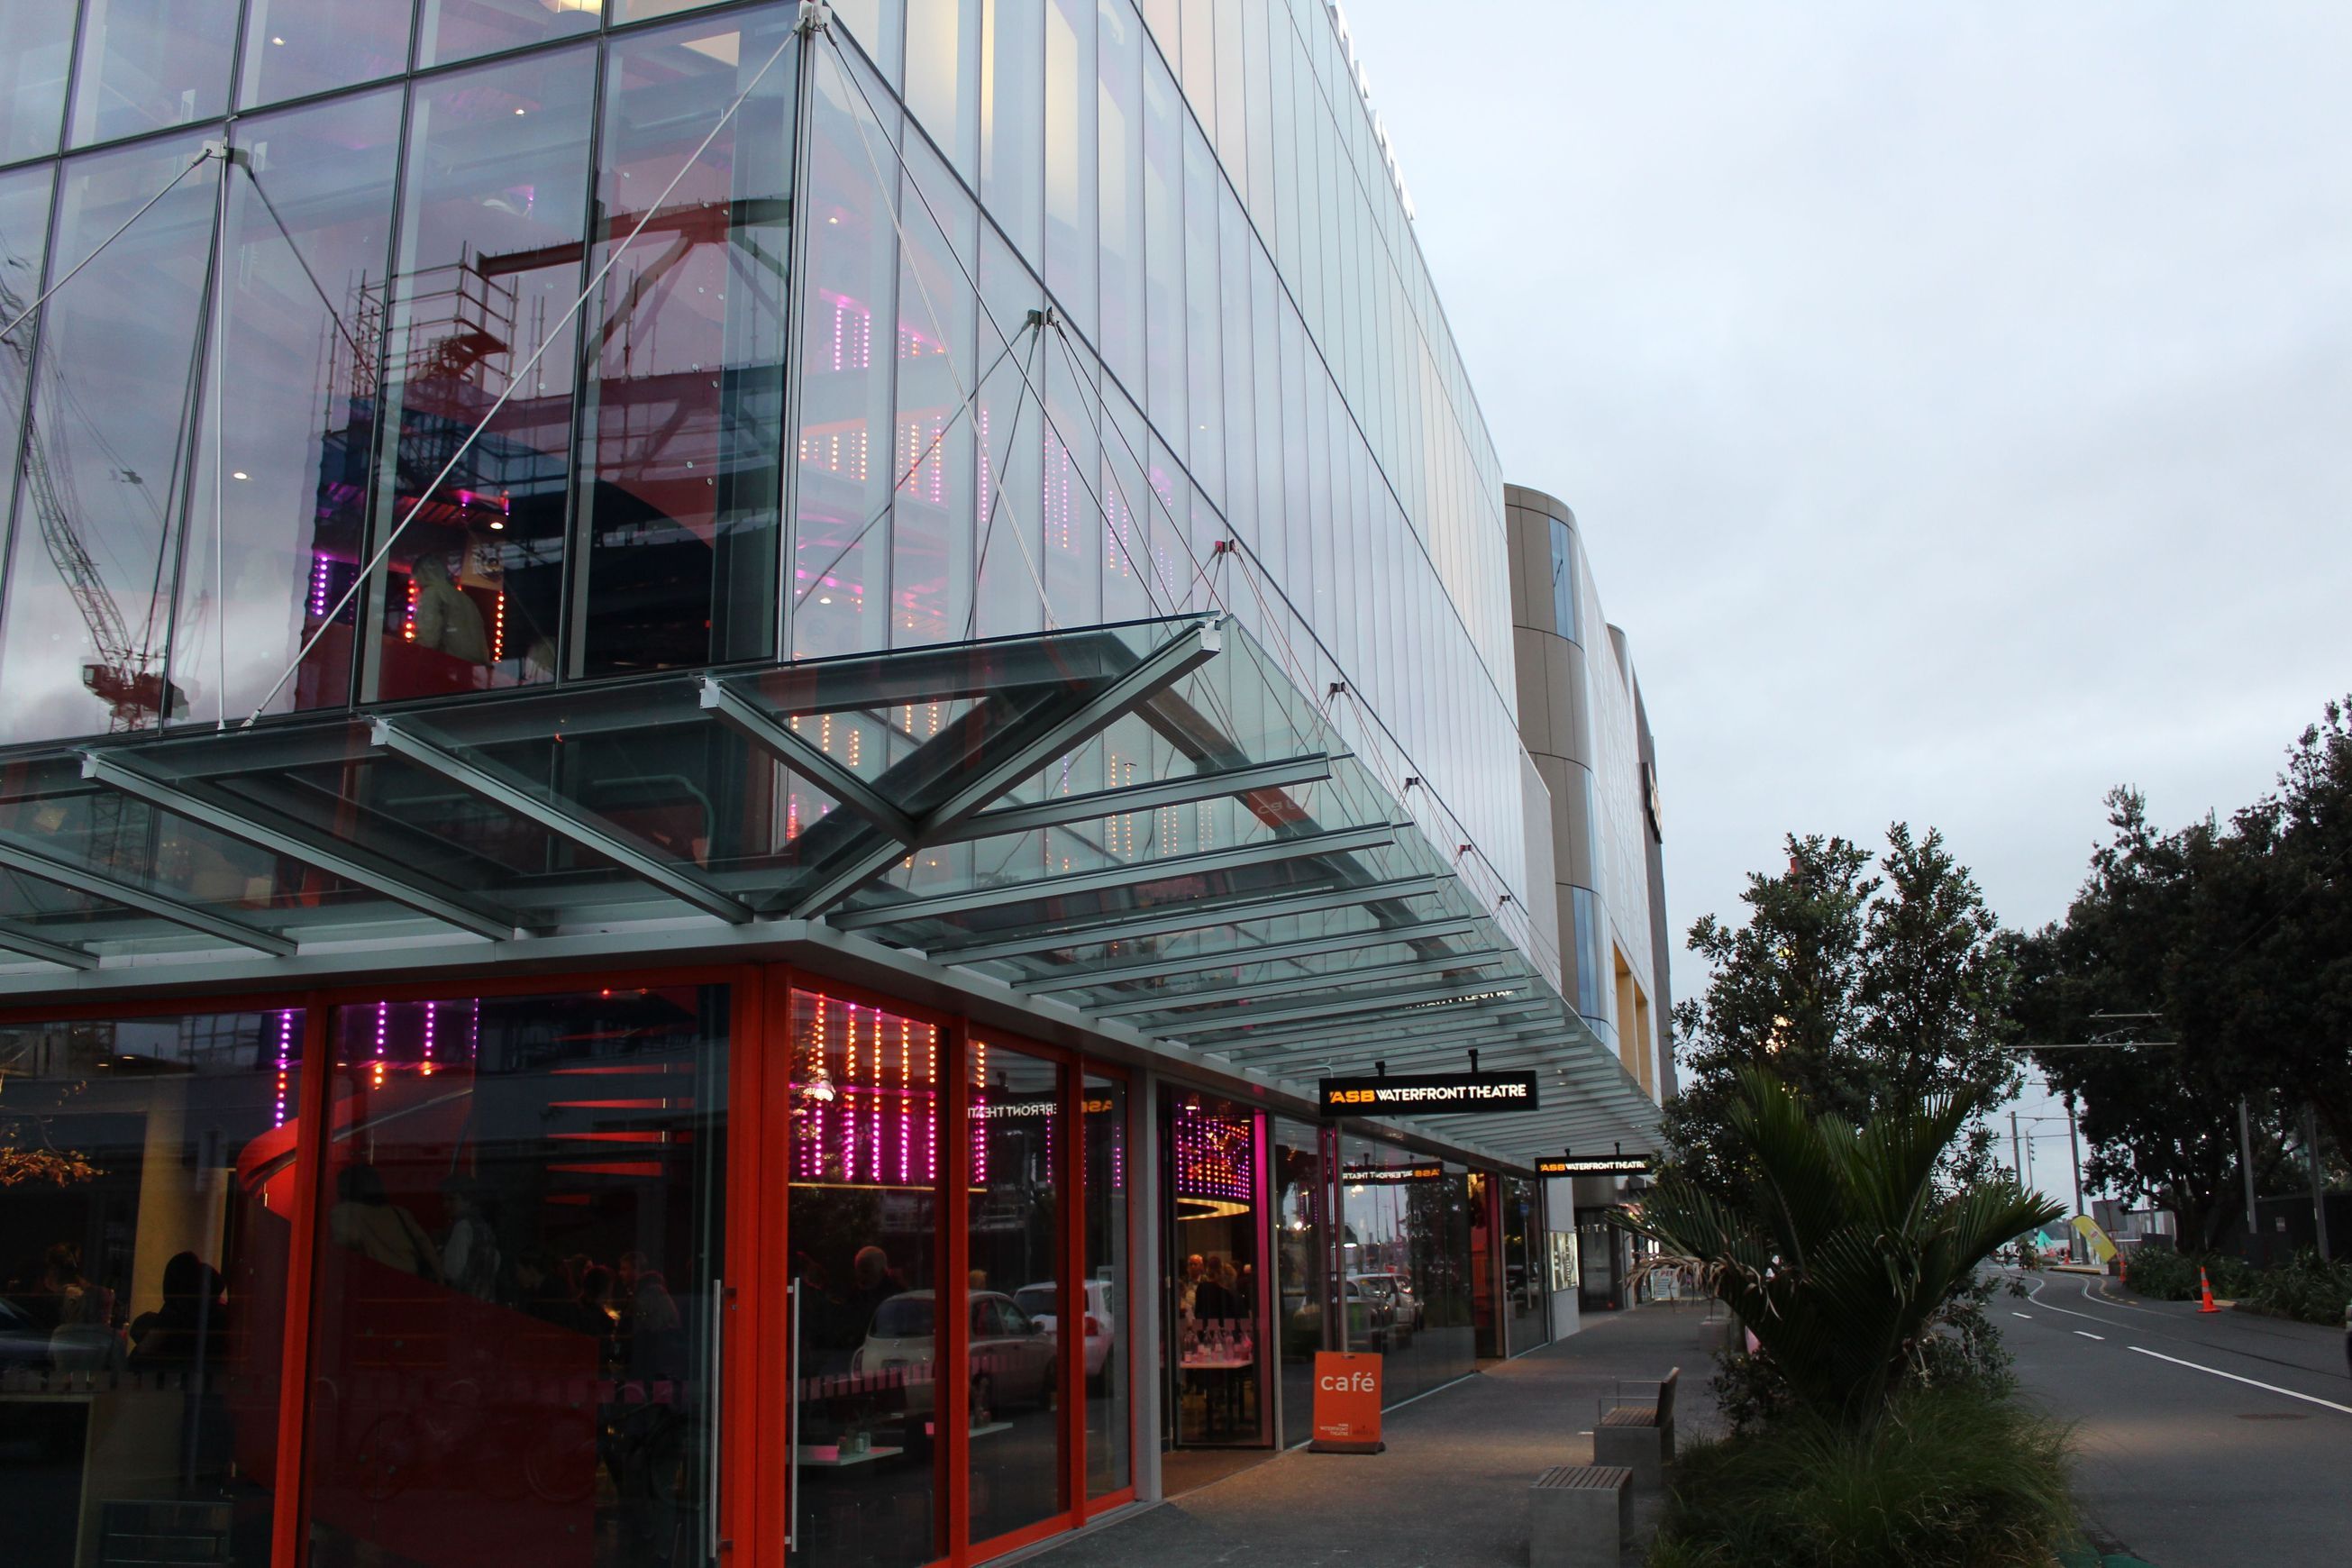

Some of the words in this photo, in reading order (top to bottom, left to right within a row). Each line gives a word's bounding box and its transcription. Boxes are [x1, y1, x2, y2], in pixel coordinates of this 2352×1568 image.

[1329, 1089, 1376, 1104] ASB
[1376, 1086, 1467, 1102] WATERFRONT
[1468, 1084, 1527, 1099] THEATRE
[1540, 1163, 1566, 1171] ASB
[1565, 1162, 1614, 1171] WATERFRONT
[1320, 1372, 1375, 1392] café
